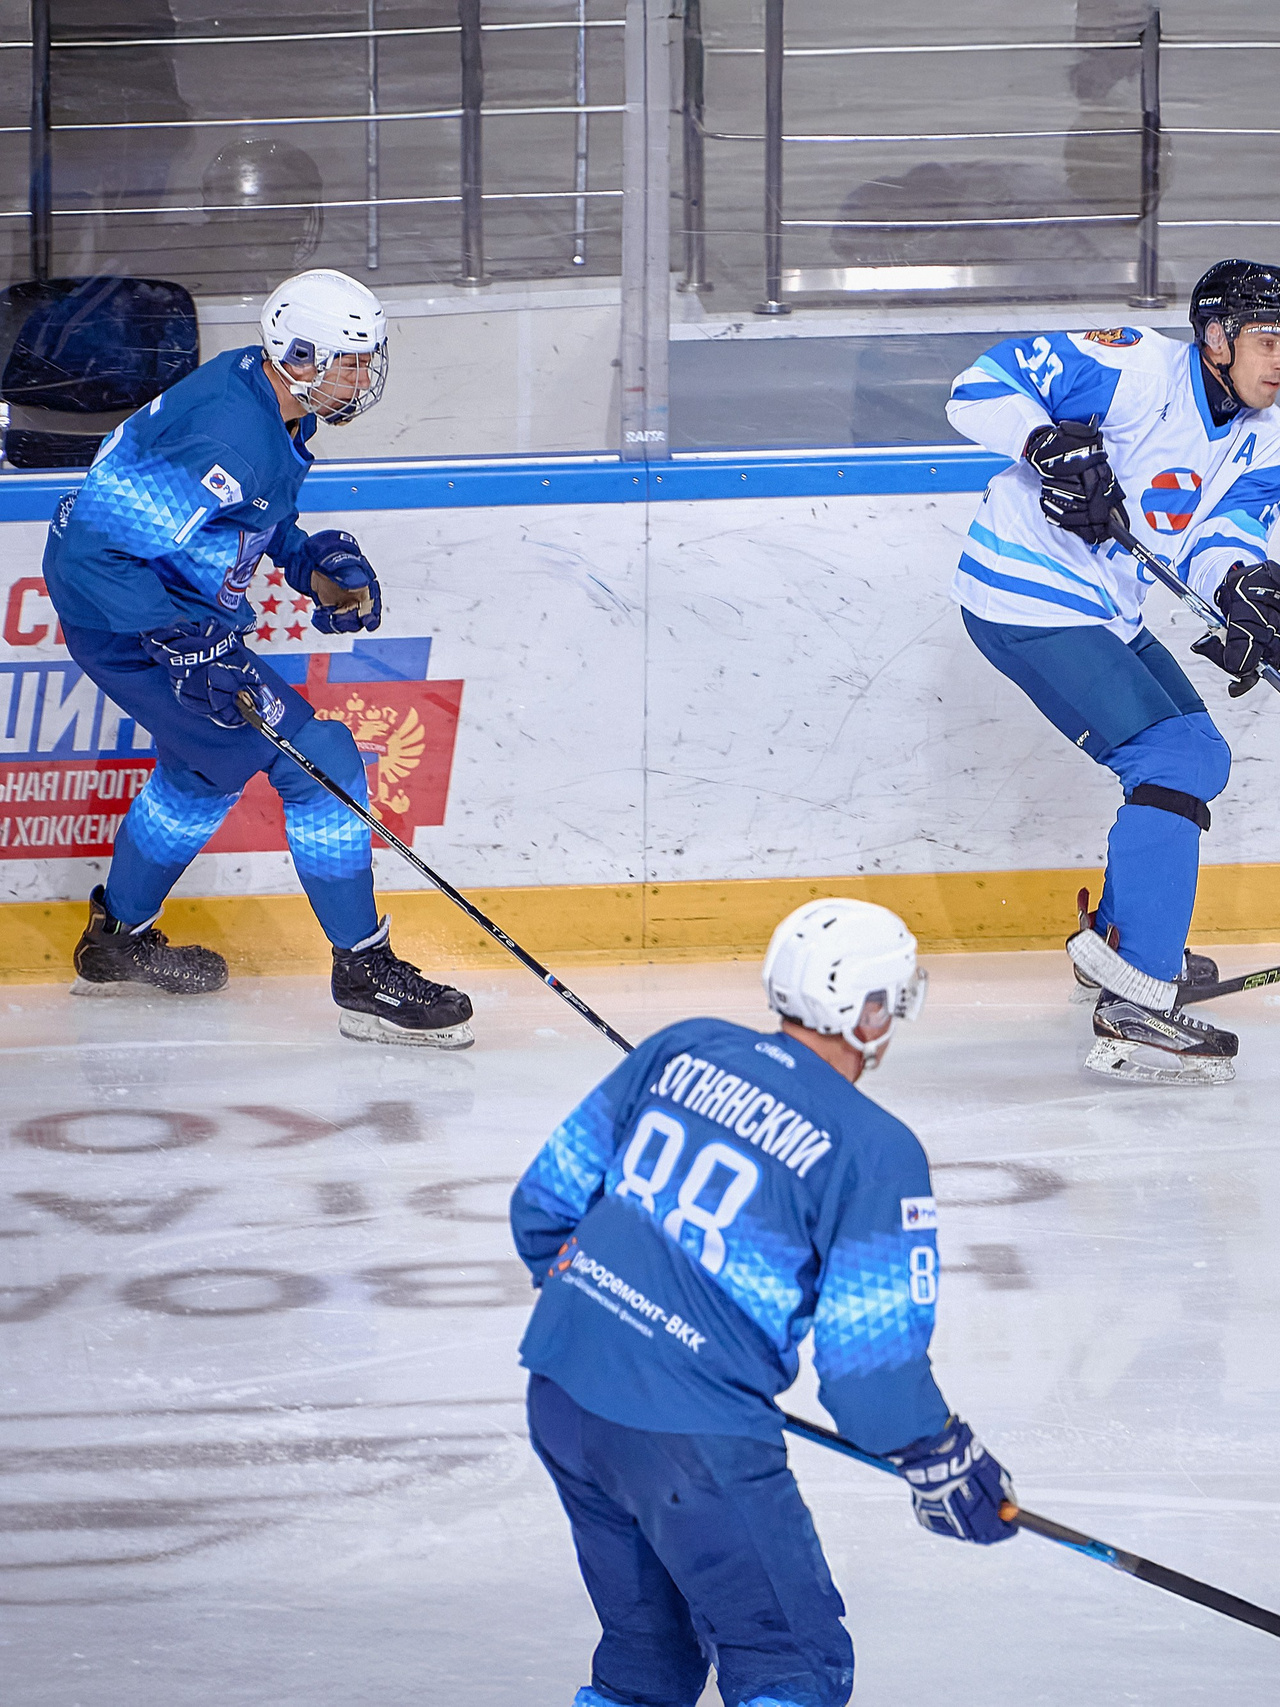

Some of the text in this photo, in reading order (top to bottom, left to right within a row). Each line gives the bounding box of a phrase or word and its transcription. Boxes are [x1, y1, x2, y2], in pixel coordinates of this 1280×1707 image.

[1199, 296, 1222, 306] CCM
[1232, 432, 1257, 466] A
[62, 768, 154, 801] ПРОГР
[650, 1053, 832, 1179] ОТНЯНСКИЙ
[615, 1110, 760, 1276] 88
[909, 1246, 936, 1305] 8
